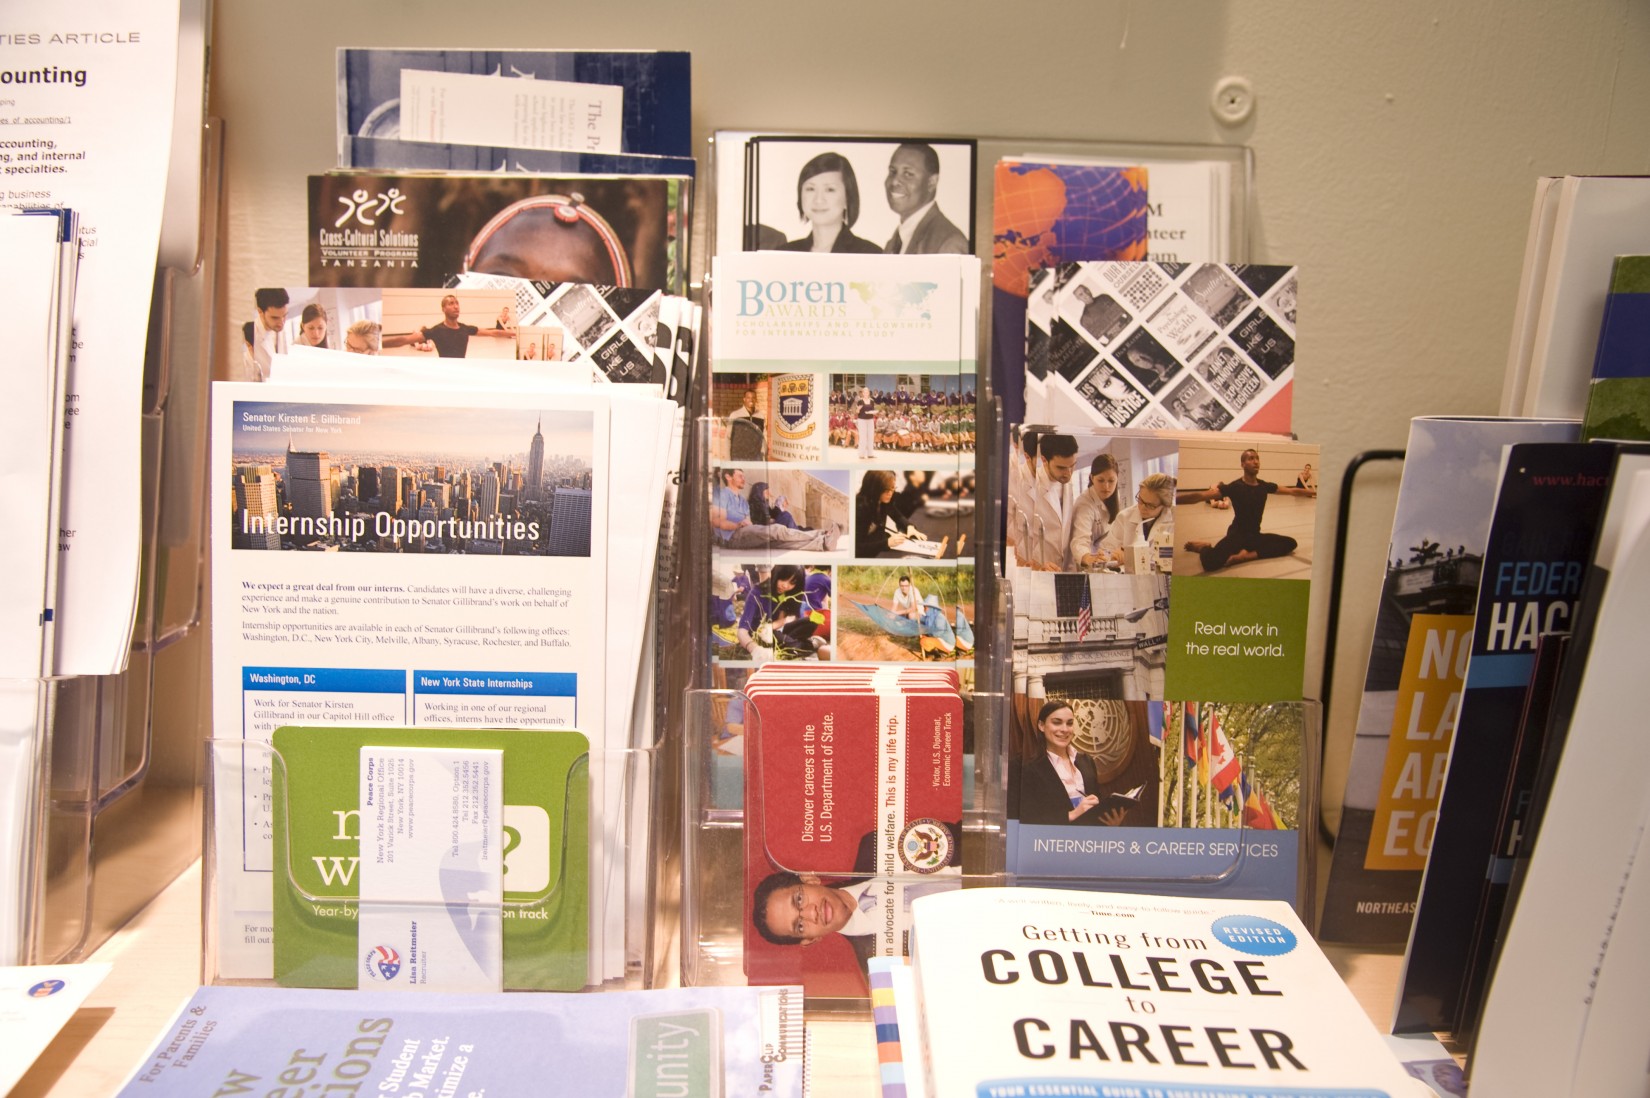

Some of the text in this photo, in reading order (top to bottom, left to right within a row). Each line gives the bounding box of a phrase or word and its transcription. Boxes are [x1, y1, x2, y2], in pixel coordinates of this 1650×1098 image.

[49, 32, 141, 45] ARTICLE
[587, 100, 602, 130] The
[17, 151, 86, 161] and internal
[5, 164, 67, 174] specialties.
[8, 190, 51, 199] business
[320, 228, 418, 247] Cross-Cultural Solutions
[321, 260, 418, 268] TANZANIA
[736, 279, 847, 317] Boren
[765, 304, 846, 317] AWARDS
[601, 333, 629, 360] GIRLS
[1261, 338, 1277, 353] US
[619, 360, 635, 375] US
[1209, 352, 1226, 375] JANET
[1212, 353, 1240, 391] EVANOVICH
[1079, 383, 1095, 399] LIS
[1180, 383, 1200, 403] COLT
[1224, 365, 1253, 401] EXPLOSIVE
[1234, 376, 1260, 409] EIGHTEEN
[243, 412, 361, 424] Senator Kirsten E. Gillibrand
[1109, 390, 1146, 428] JUSTICE
[243, 509, 541, 543] Internship Opportunities
[242, 582, 254, 590] We
[258, 583, 283, 591] expect
[293, 584, 314, 592] great
[316, 583, 333, 591] deal
[335, 583, 355, 591] from
[407, 585, 450, 594] Candidates
[452, 586, 467, 594] will
[469, 587, 487, 595] have
[495, 587, 525, 595] diverse,
[527, 587, 572, 597] challenging
[242, 622, 280, 632] Internship
[283, 623, 332, 632] opportunities
[348, 624, 383, 632] available
[425, 625, 454, 633] Senator
[503, 627, 540, 636] following
[542, 628, 570, 636] offices:
[1194, 621, 1278, 636] Real work in
[242, 633, 290, 643] Washington,
[292, 634, 312, 642] D.C.,
[335, 635, 353, 643] York
[355, 635, 373, 645] City,
[376, 635, 410, 645] Melville,
[412, 637, 441, 646] Albany,
[444, 638, 480, 647] Syracuse,
[482, 638, 522, 647] Rochester,
[540, 638, 572, 647] Buffalo.
[1186, 642, 1284, 657] the real world.
[250, 673, 315, 685] Washington, DC
[421, 677, 533, 690] New York State Internships
[886, 715, 899, 735] trip.
[944, 712, 952, 730] Track
[933, 717, 942, 749] Diplomat,
[943, 731, 951, 752] Career
[886, 738, 896, 754] life
[888, 757, 898, 772] my
[801, 724, 815, 842] Discover careers at the
[820, 712, 835, 842] U.S. Department of State.
[886, 775, 896, 783] is
[932, 766, 941, 786] Victor,
[377, 785, 385, 821] Regional
[886, 787, 896, 807] This
[885, 811, 896, 850] welfare.
[1034, 838, 1278, 858] INTERNSHIPS & CAREER SERVICES
[884, 880, 894, 895] for
[519, 908, 549, 919] track
[884, 898, 894, 945] advocate
[1021, 924, 1209, 951] Getting from
[1223, 926, 1282, 936] REVISED
[1228, 934, 1286, 944] EDITION
[980, 949, 1284, 997] COLLEGE
[1125, 995, 1157, 1015] to
[139, 1006, 207, 1083] For Parents &
[172, 1020, 217, 1068] Families
[1012, 1017, 1310, 1072] CAREER
[378, 1038, 420, 1092] Student
[408, 1036, 450, 1090] Market.
